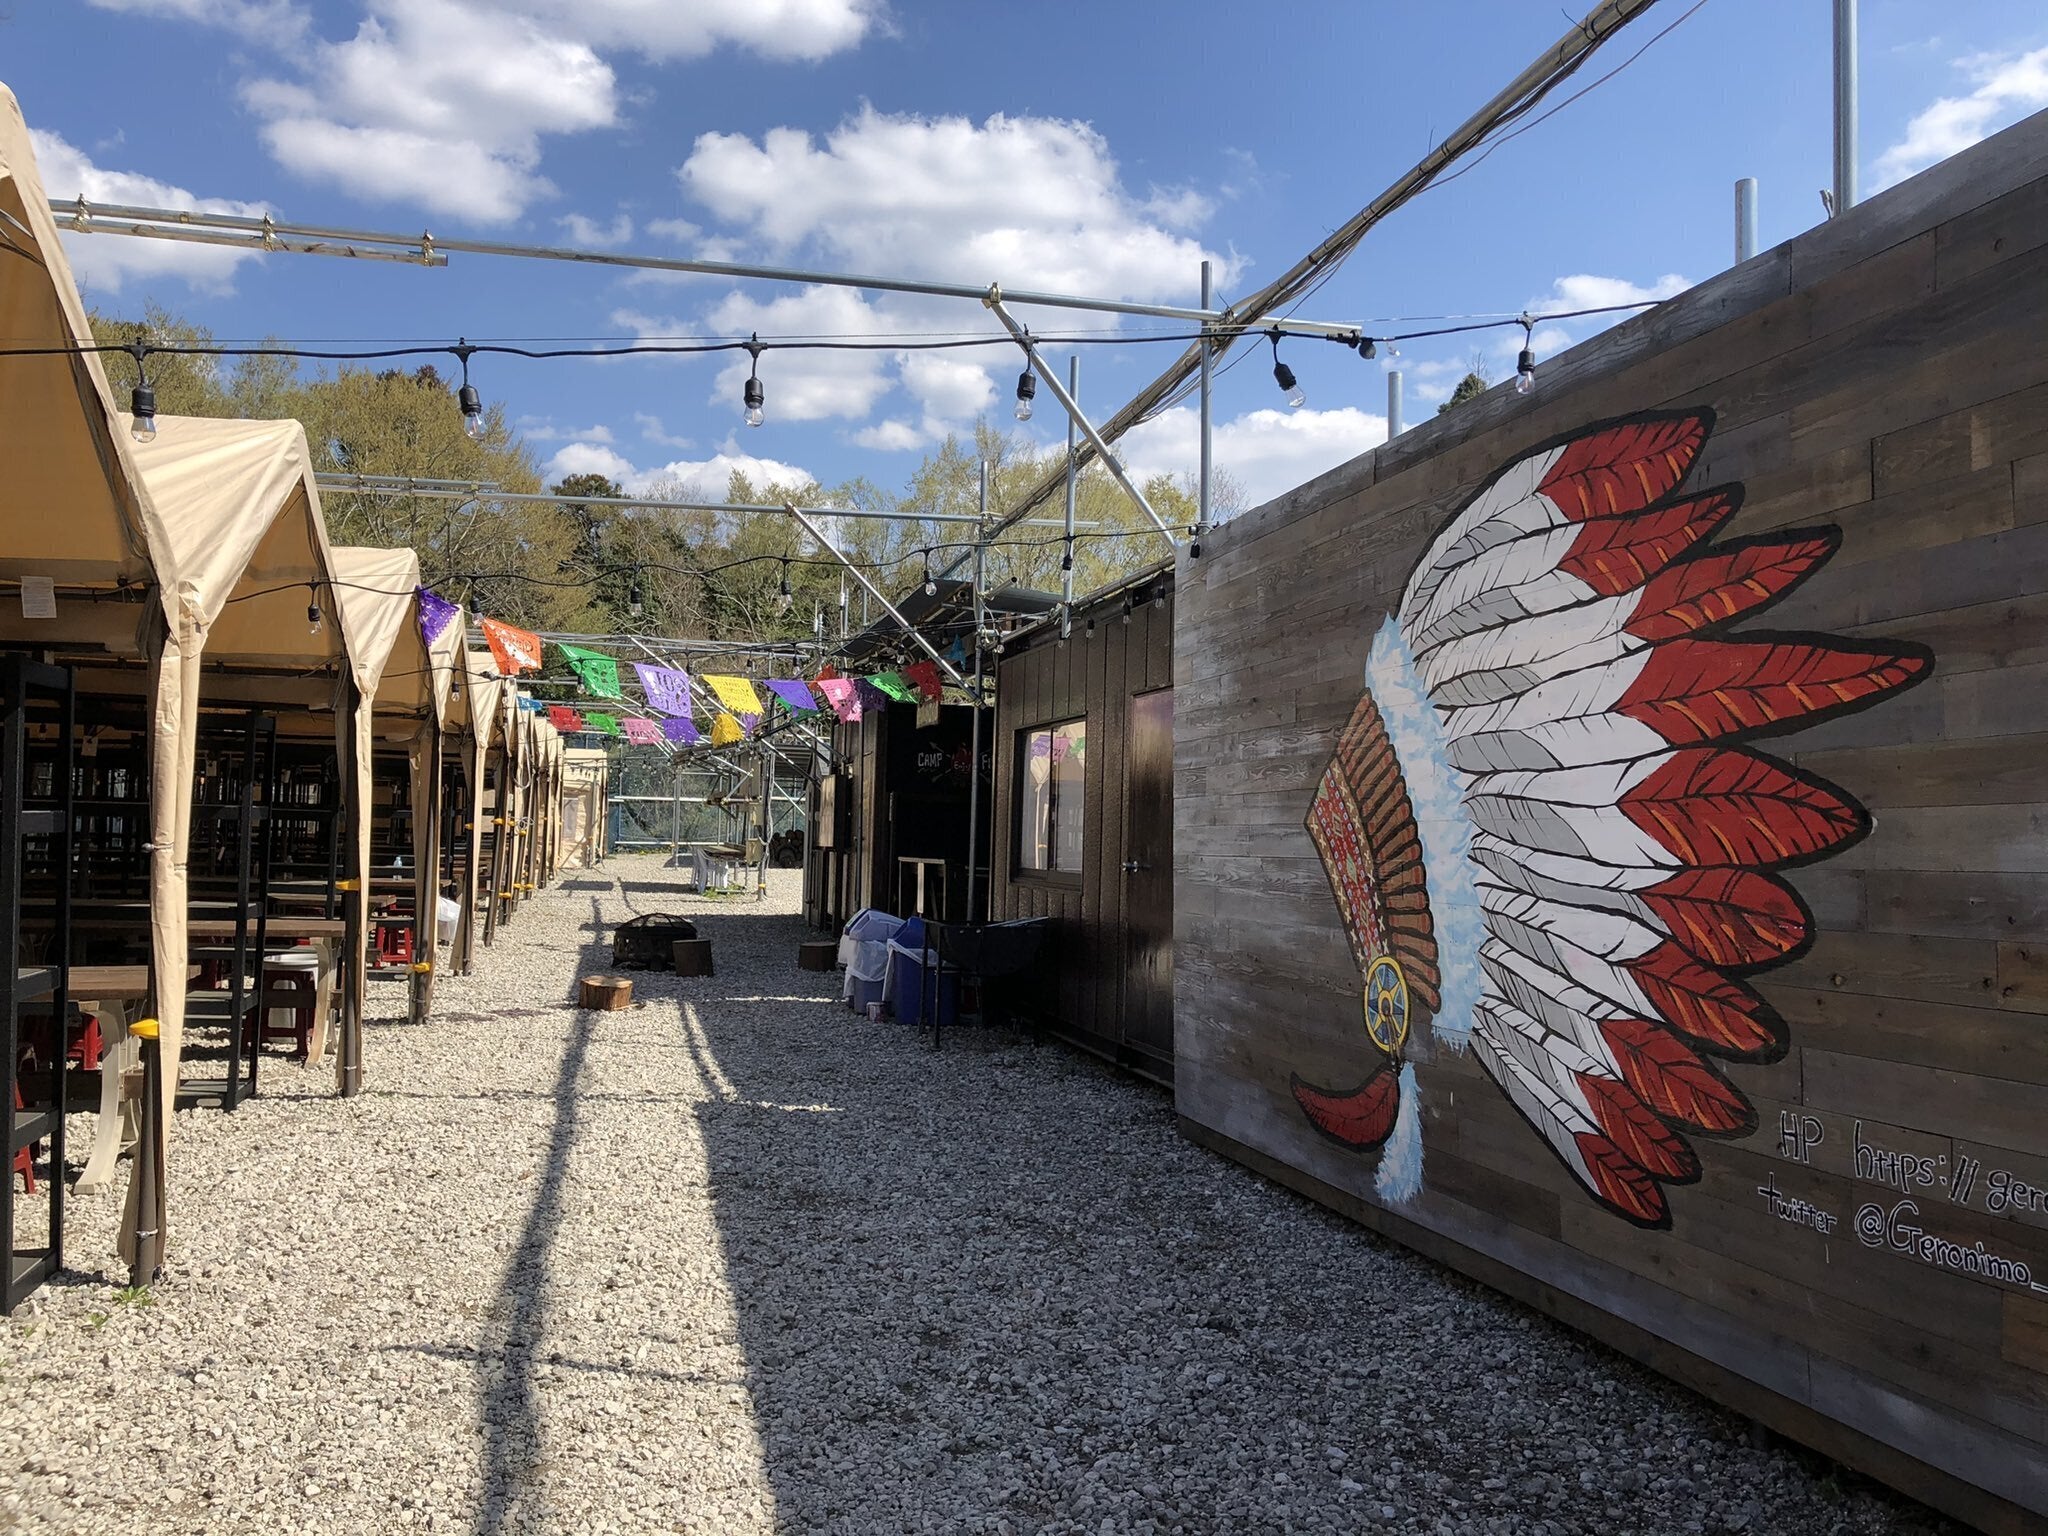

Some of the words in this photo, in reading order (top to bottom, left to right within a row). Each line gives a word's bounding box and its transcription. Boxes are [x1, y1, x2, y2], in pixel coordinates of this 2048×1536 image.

[917, 752, 944, 768] CAMP
[1780, 1110, 1825, 1164] HP
[1757, 1171, 1838, 1234] twitter
